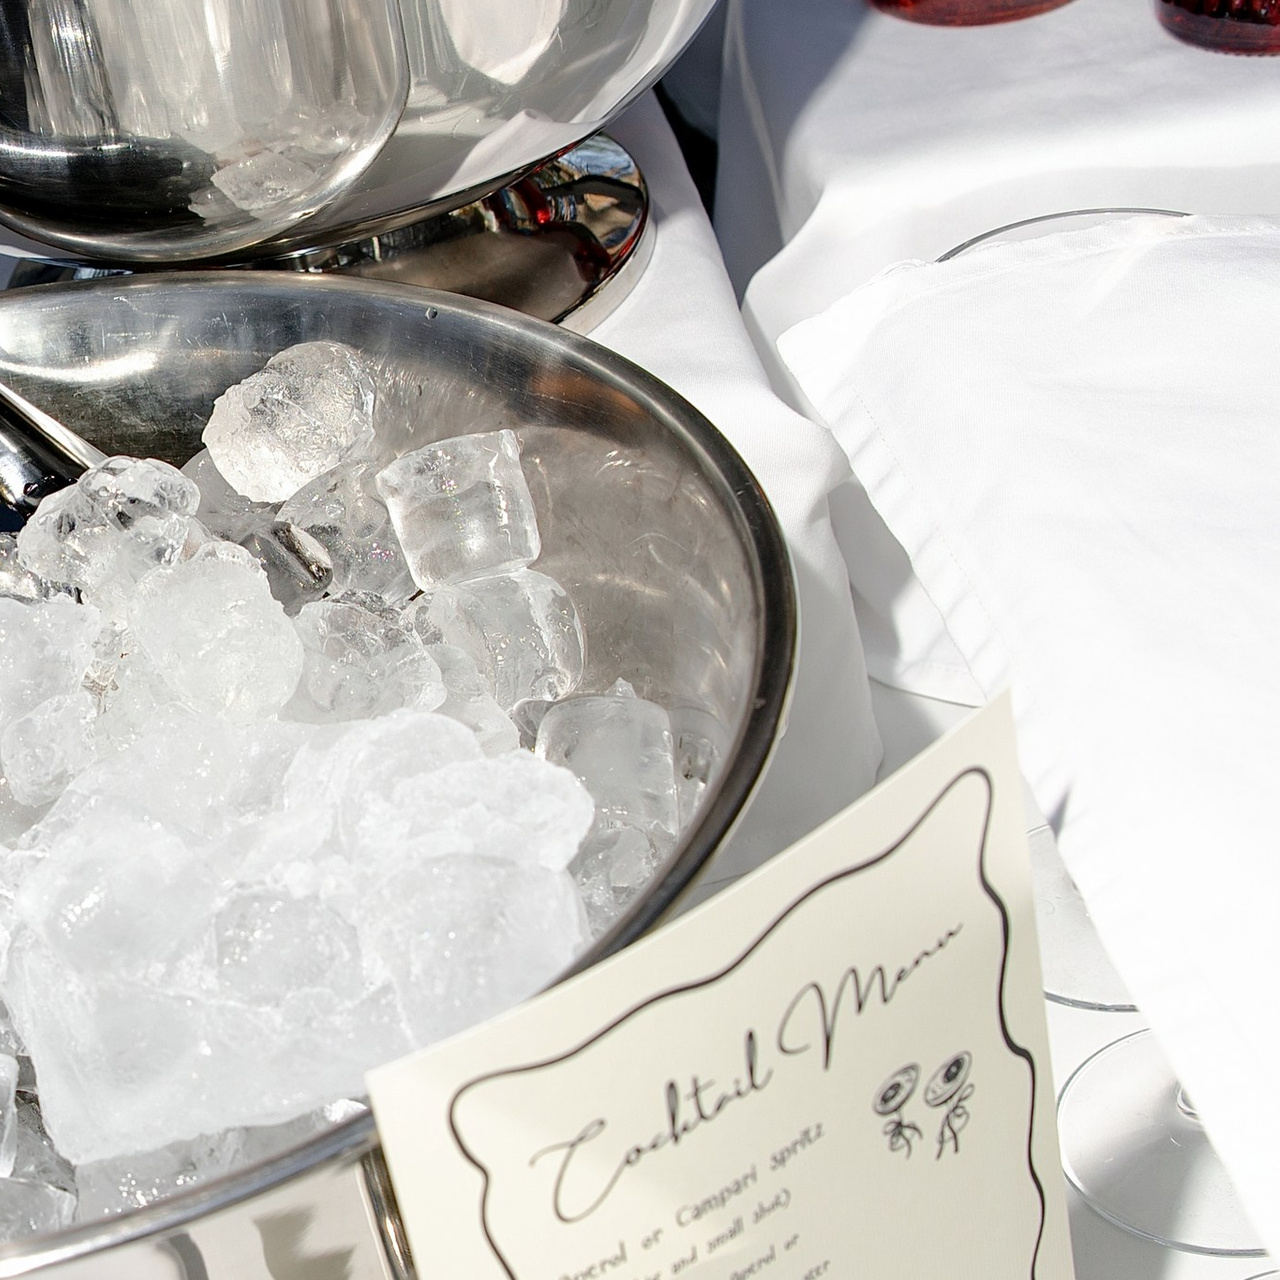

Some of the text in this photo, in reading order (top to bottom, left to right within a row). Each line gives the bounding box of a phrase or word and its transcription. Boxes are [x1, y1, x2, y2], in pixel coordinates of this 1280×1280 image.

[529, 922, 963, 1223] Cocktail Menu
[641, 1228, 663, 1250] or
[676, 1165, 757, 1226] Campari
[769, 1123, 825, 1172] spritz
